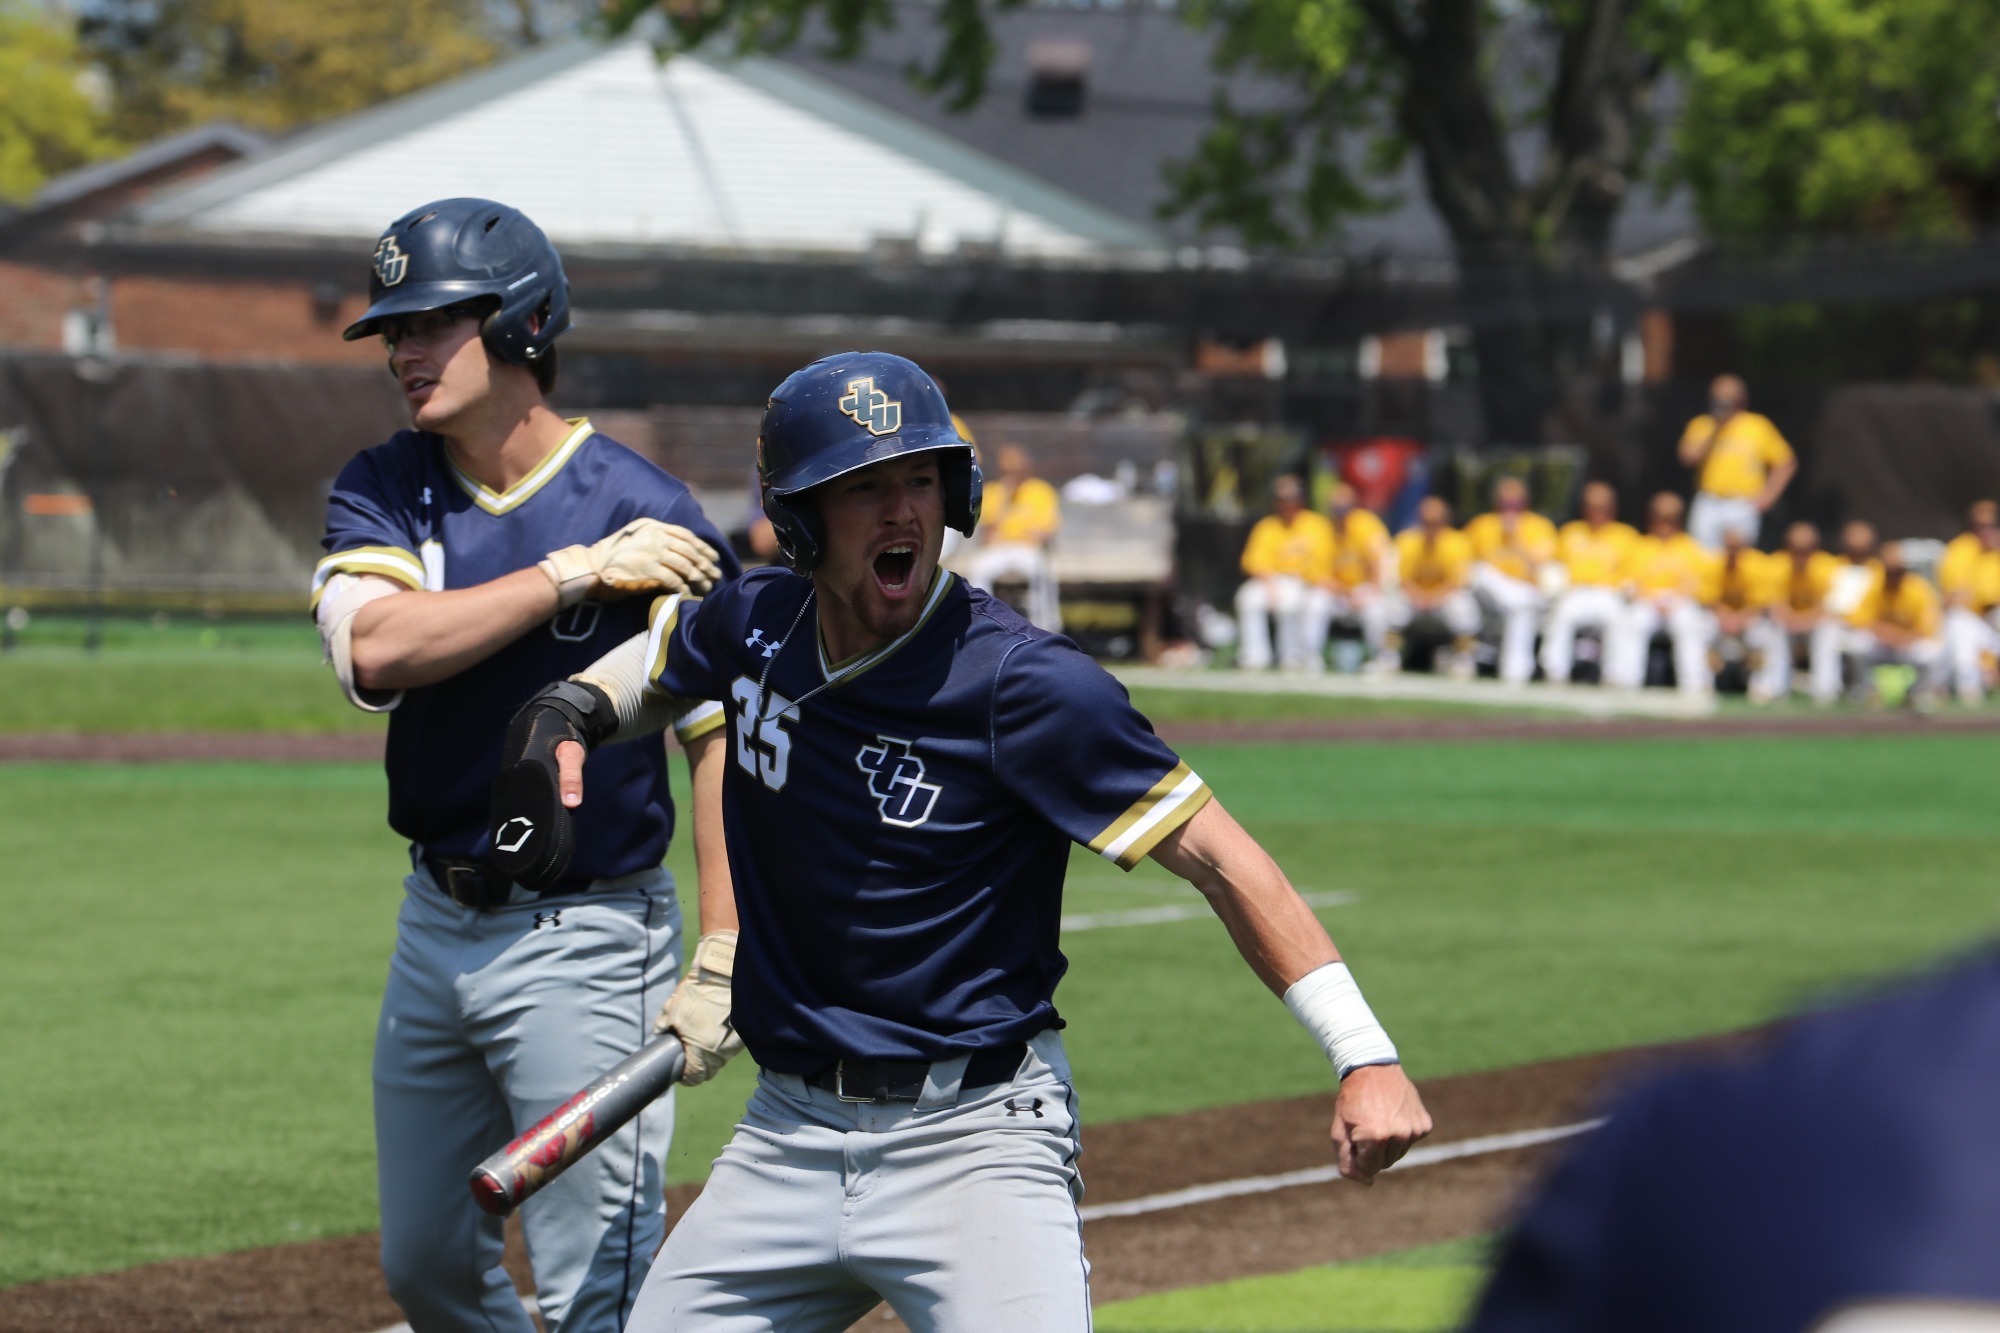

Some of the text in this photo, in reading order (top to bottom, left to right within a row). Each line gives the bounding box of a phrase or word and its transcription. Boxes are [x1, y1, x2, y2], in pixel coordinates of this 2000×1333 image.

[839, 376, 902, 436] JCU
[731, 673, 800, 794] 25
[855, 733, 943, 828] JCU
